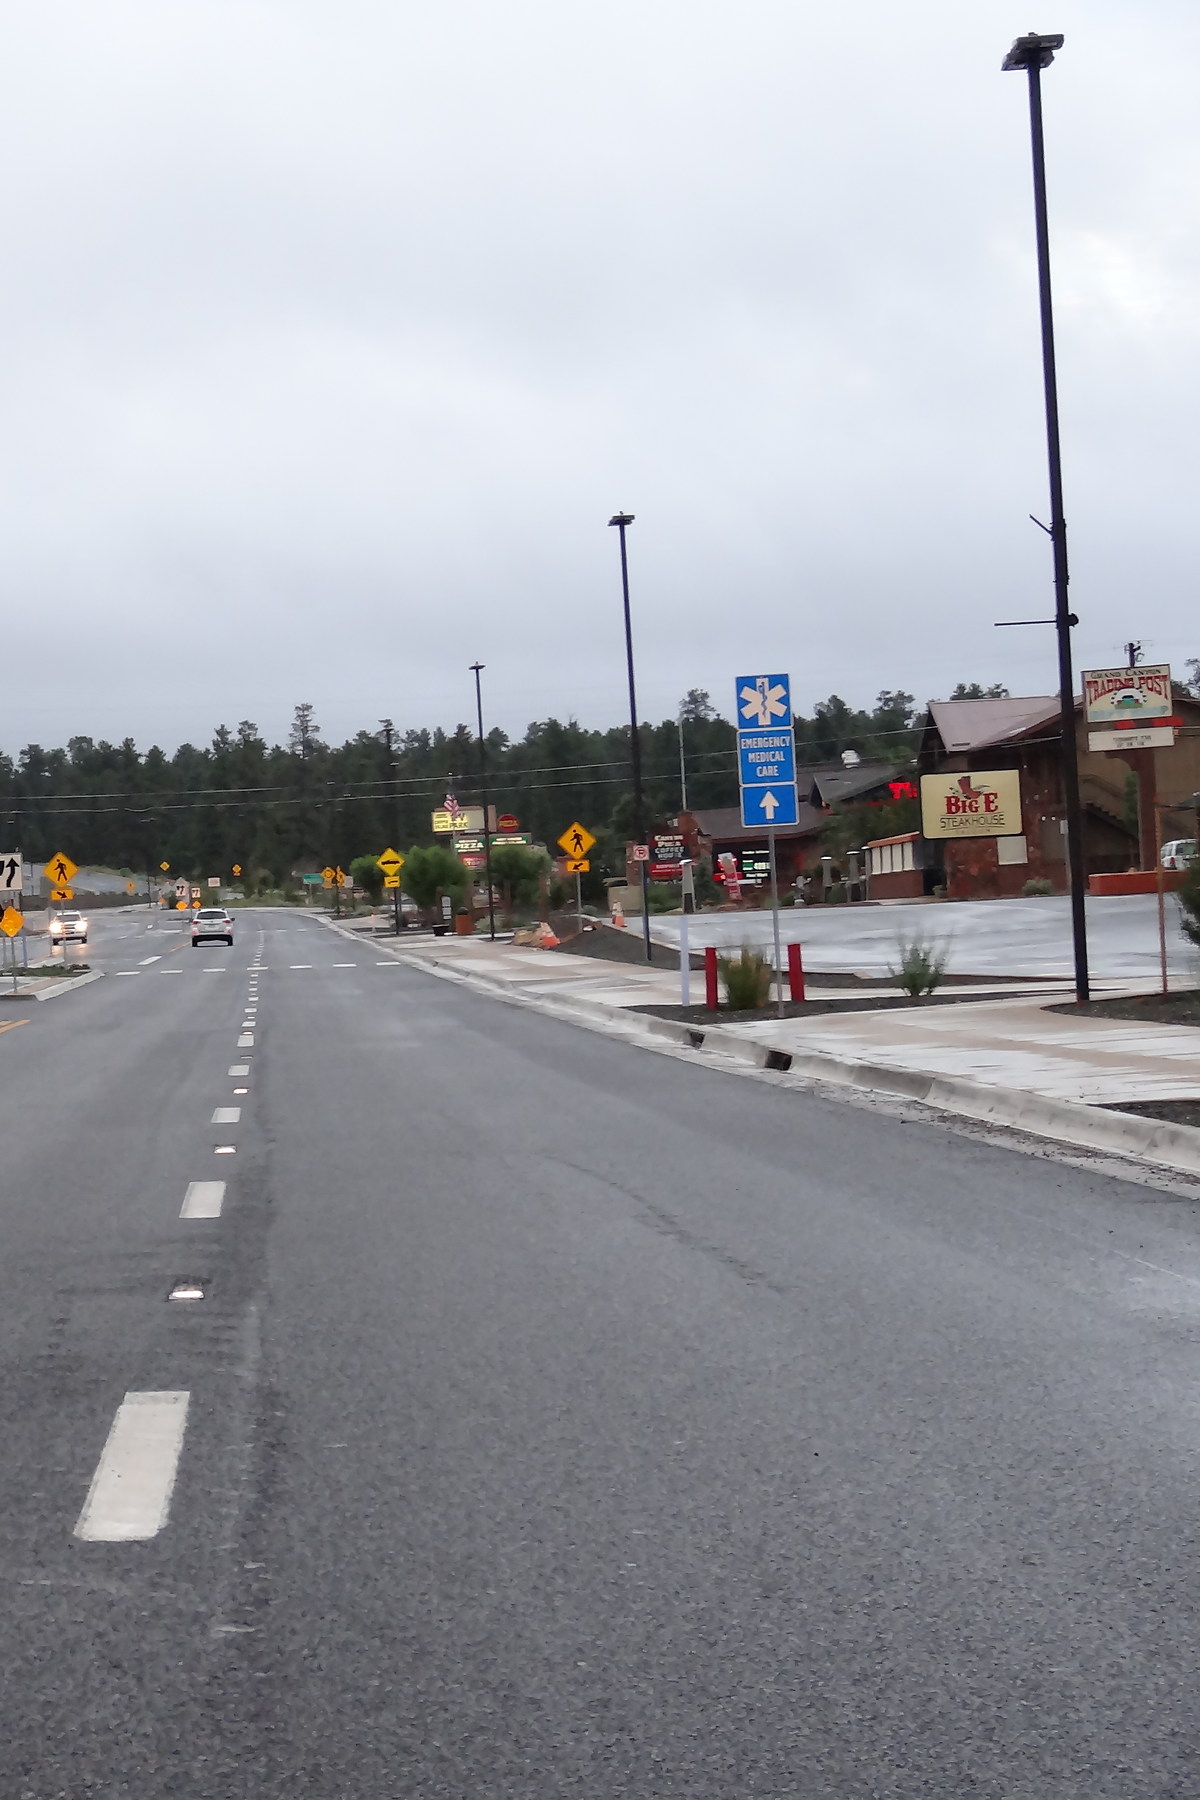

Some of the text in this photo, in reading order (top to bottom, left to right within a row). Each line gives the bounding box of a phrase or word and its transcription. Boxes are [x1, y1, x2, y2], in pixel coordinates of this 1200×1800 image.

[1125, 668, 1161, 677] CANYON
[1085, 674, 1169, 707] TRADING POST
[741, 736, 790, 750] EMERGENCY
[748, 751, 785, 763] MEDICAL
[756, 765, 779, 777] CARE
[944, 792, 999, 815] BIG E
[939, 813, 1006, 829] STEAKHOUSE
